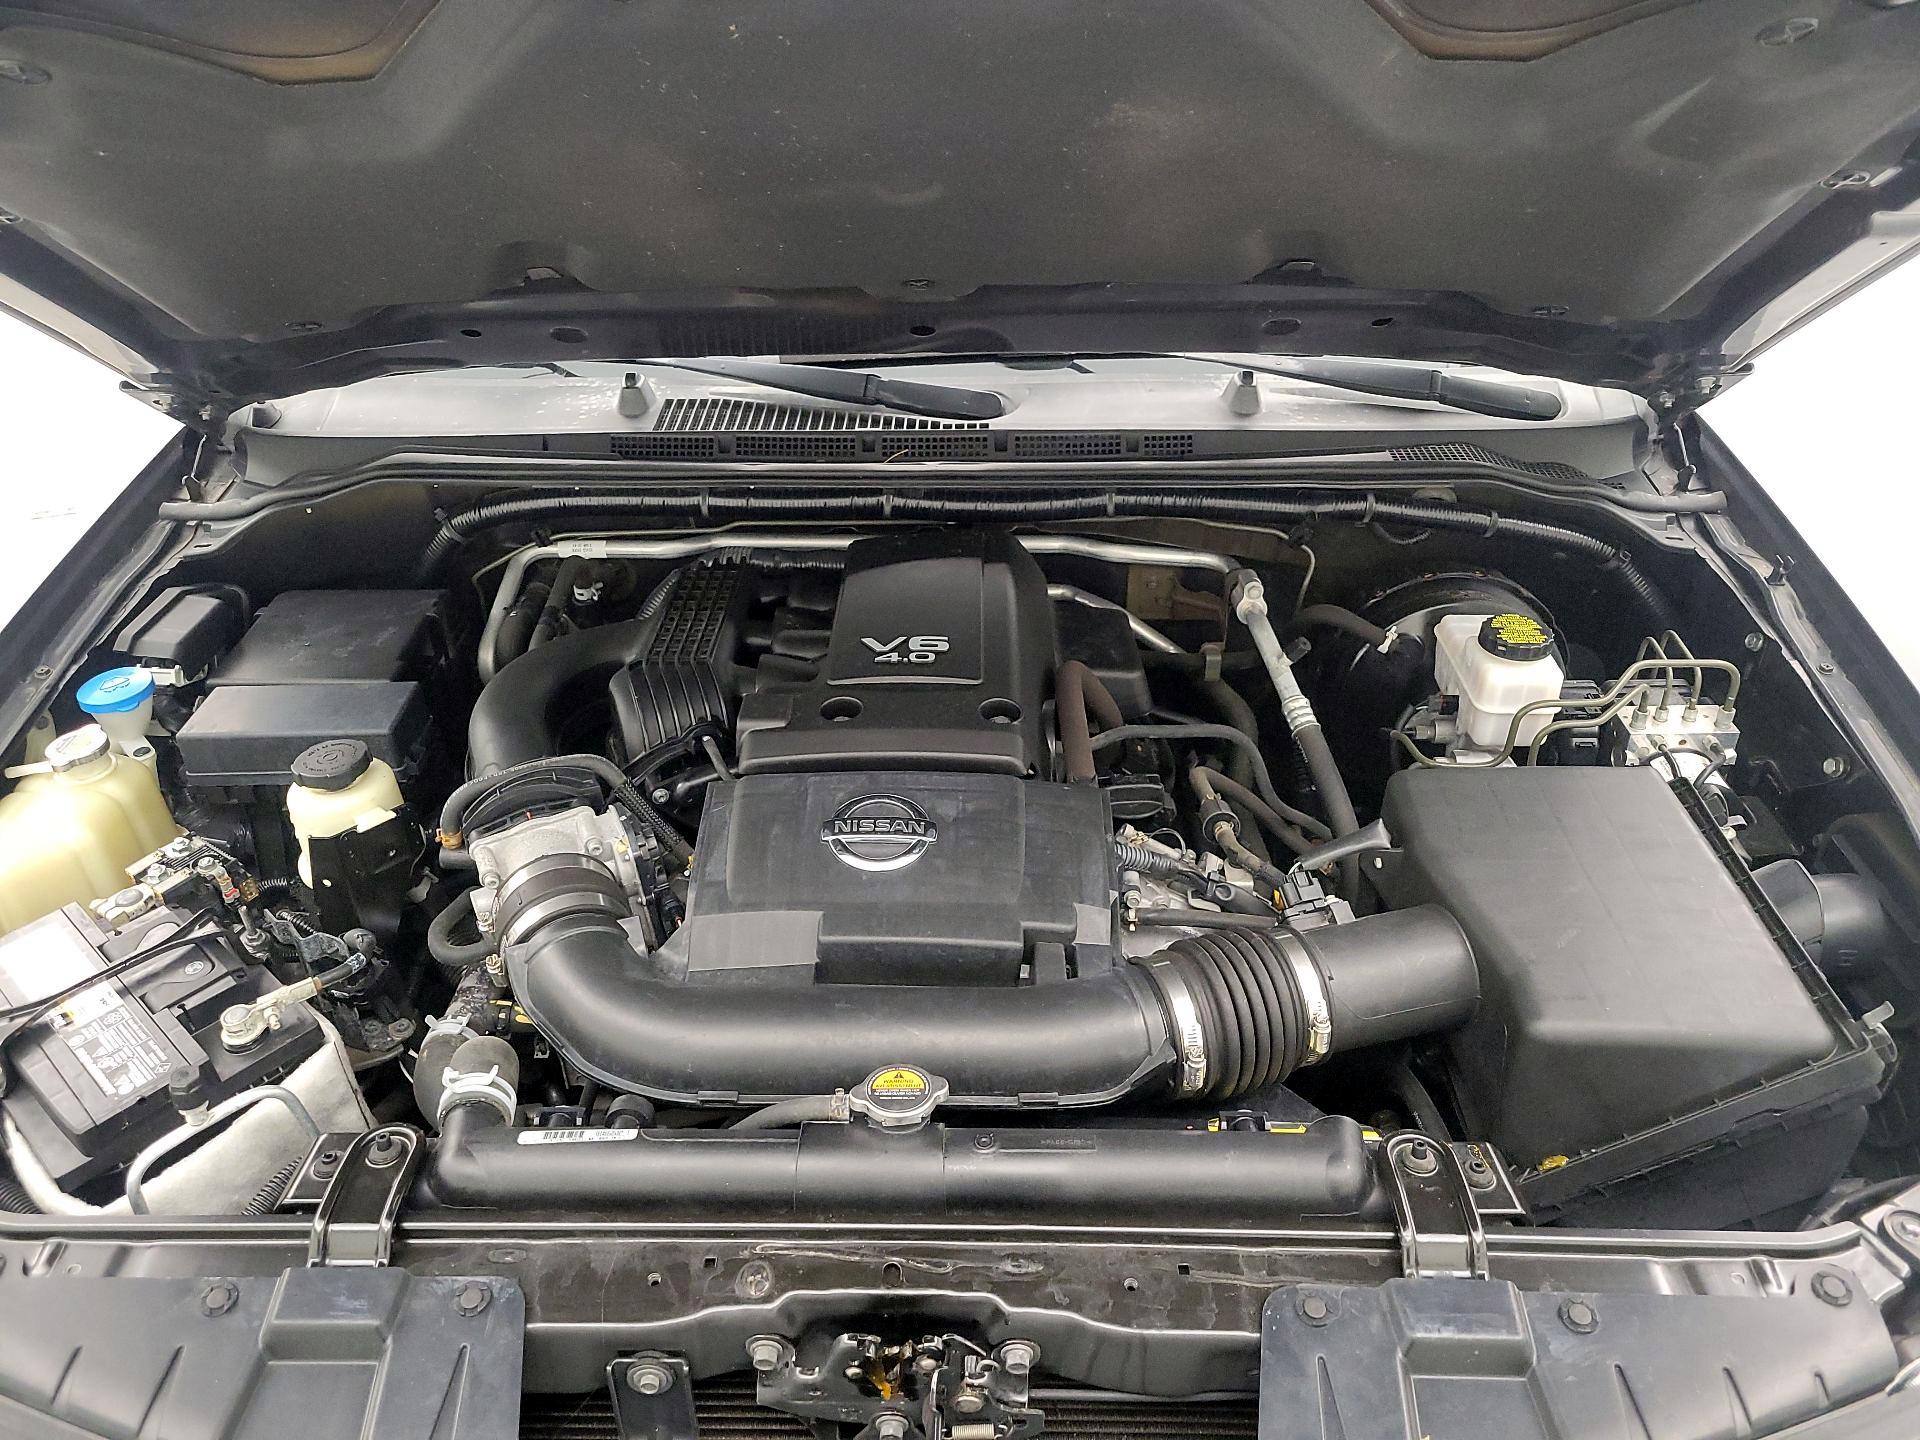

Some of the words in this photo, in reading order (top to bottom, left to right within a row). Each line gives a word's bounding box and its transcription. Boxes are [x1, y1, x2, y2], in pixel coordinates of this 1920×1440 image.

[861, 635, 950, 652] V6
[874, 652, 936, 663] 4.0
[834, 820, 925, 833] NISSAN
